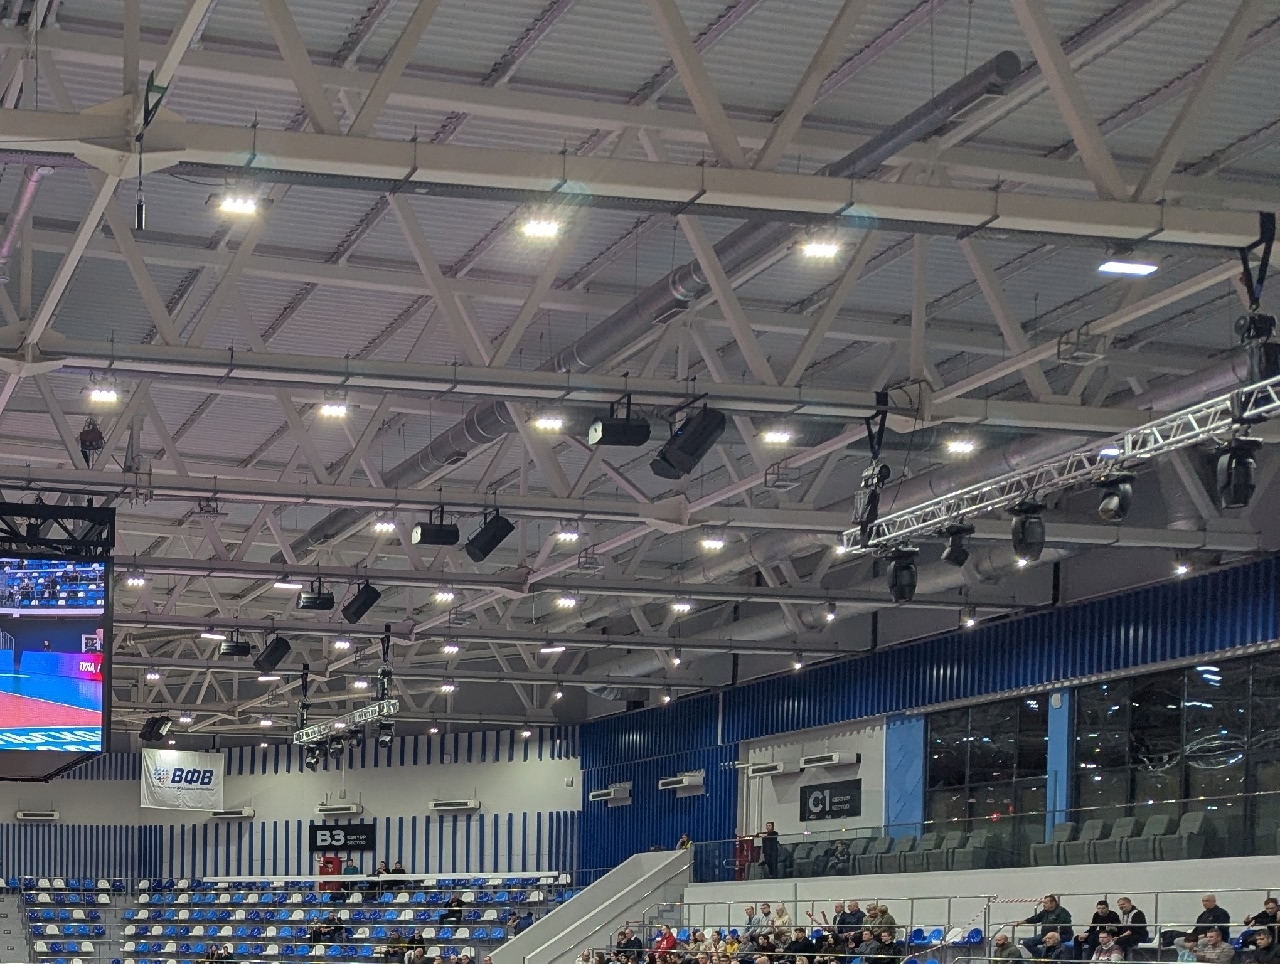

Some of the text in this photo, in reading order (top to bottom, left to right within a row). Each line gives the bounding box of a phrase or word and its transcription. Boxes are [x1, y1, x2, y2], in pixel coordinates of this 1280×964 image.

[170, 768, 214, 785] ВФВ
[808, 789, 830, 813] C1
[316, 829, 345, 847] B3
